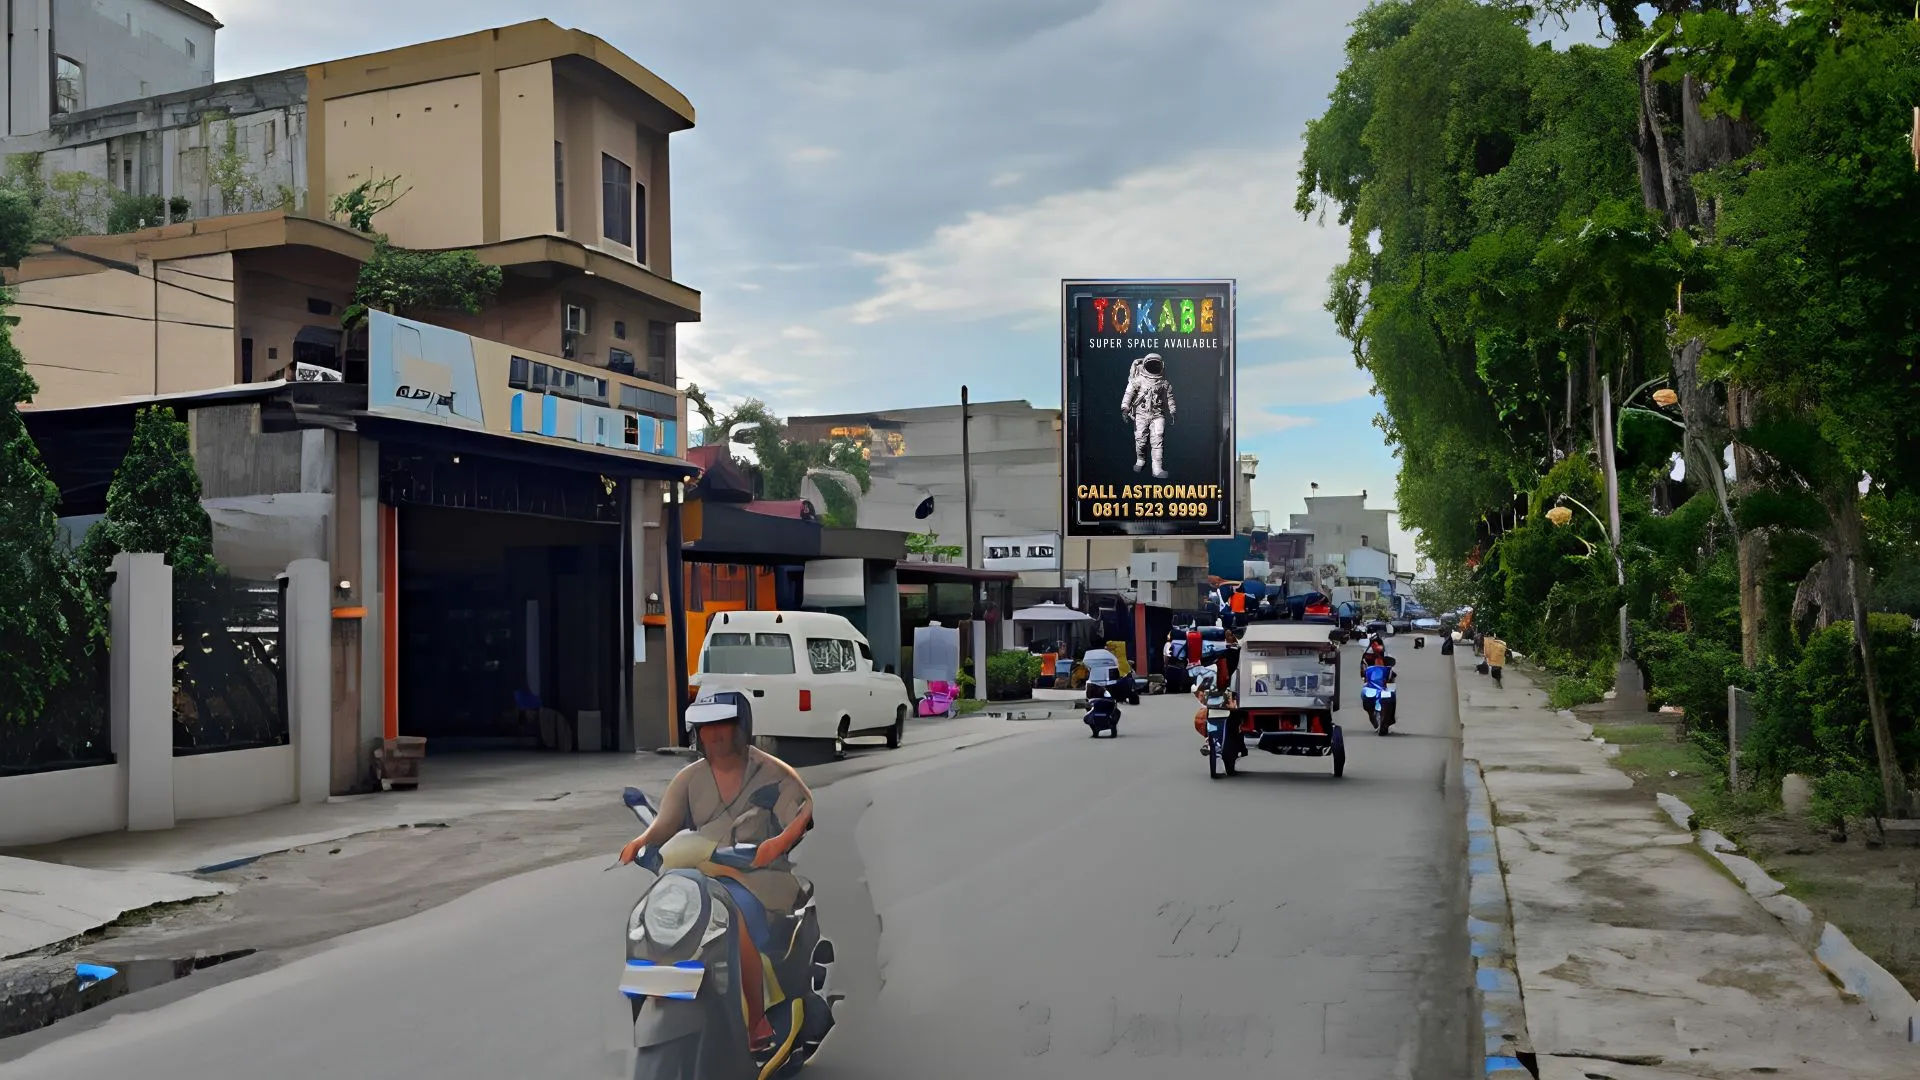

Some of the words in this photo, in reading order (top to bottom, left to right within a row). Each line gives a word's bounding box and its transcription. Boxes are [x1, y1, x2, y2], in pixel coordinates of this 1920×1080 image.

[1094, 298, 1214, 333] TOKABE
[1089, 338, 1122, 349] SUPER
[1127, 338, 1159, 349] SPACE
[1164, 338, 1218, 349] AVAILABLE
[1077, 484, 1117, 499] CALL
[1122, 484, 1222, 499] ASTRONAUT:
[1092, 502, 1129, 517] 0811
[1135, 502, 1164, 517] 523
[1168, 502, 1208, 517] 9999
